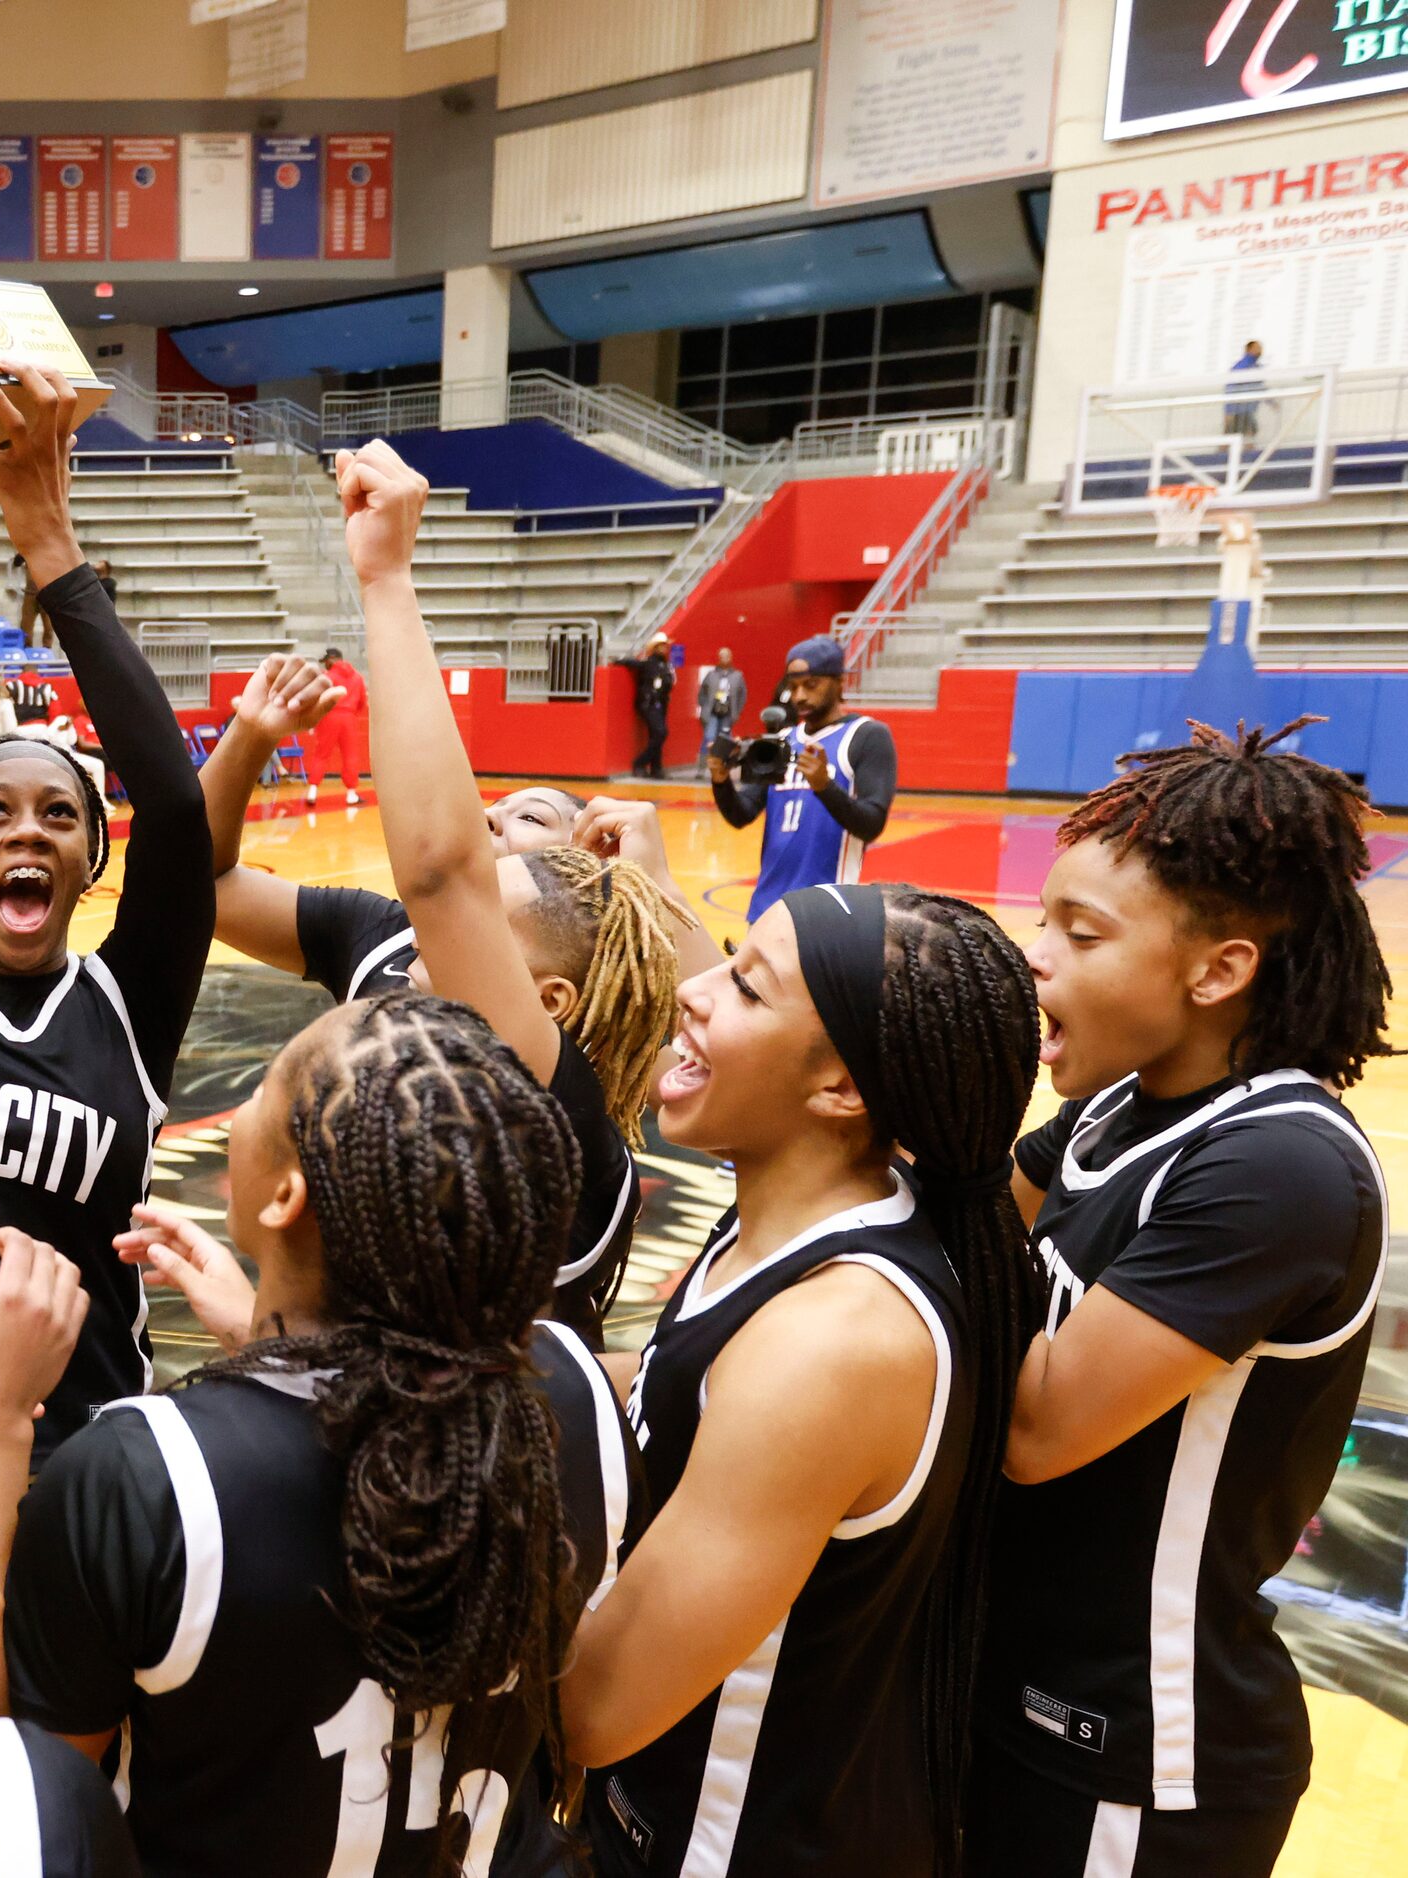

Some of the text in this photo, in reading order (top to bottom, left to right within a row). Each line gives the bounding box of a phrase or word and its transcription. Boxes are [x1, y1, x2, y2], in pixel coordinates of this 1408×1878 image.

[1195, 220, 1265, 242] Sandra
[1273, 206, 1369, 230] Meadows
[1237, 233, 1310, 254] Classic
[1078, 1722, 1093, 1739] S
